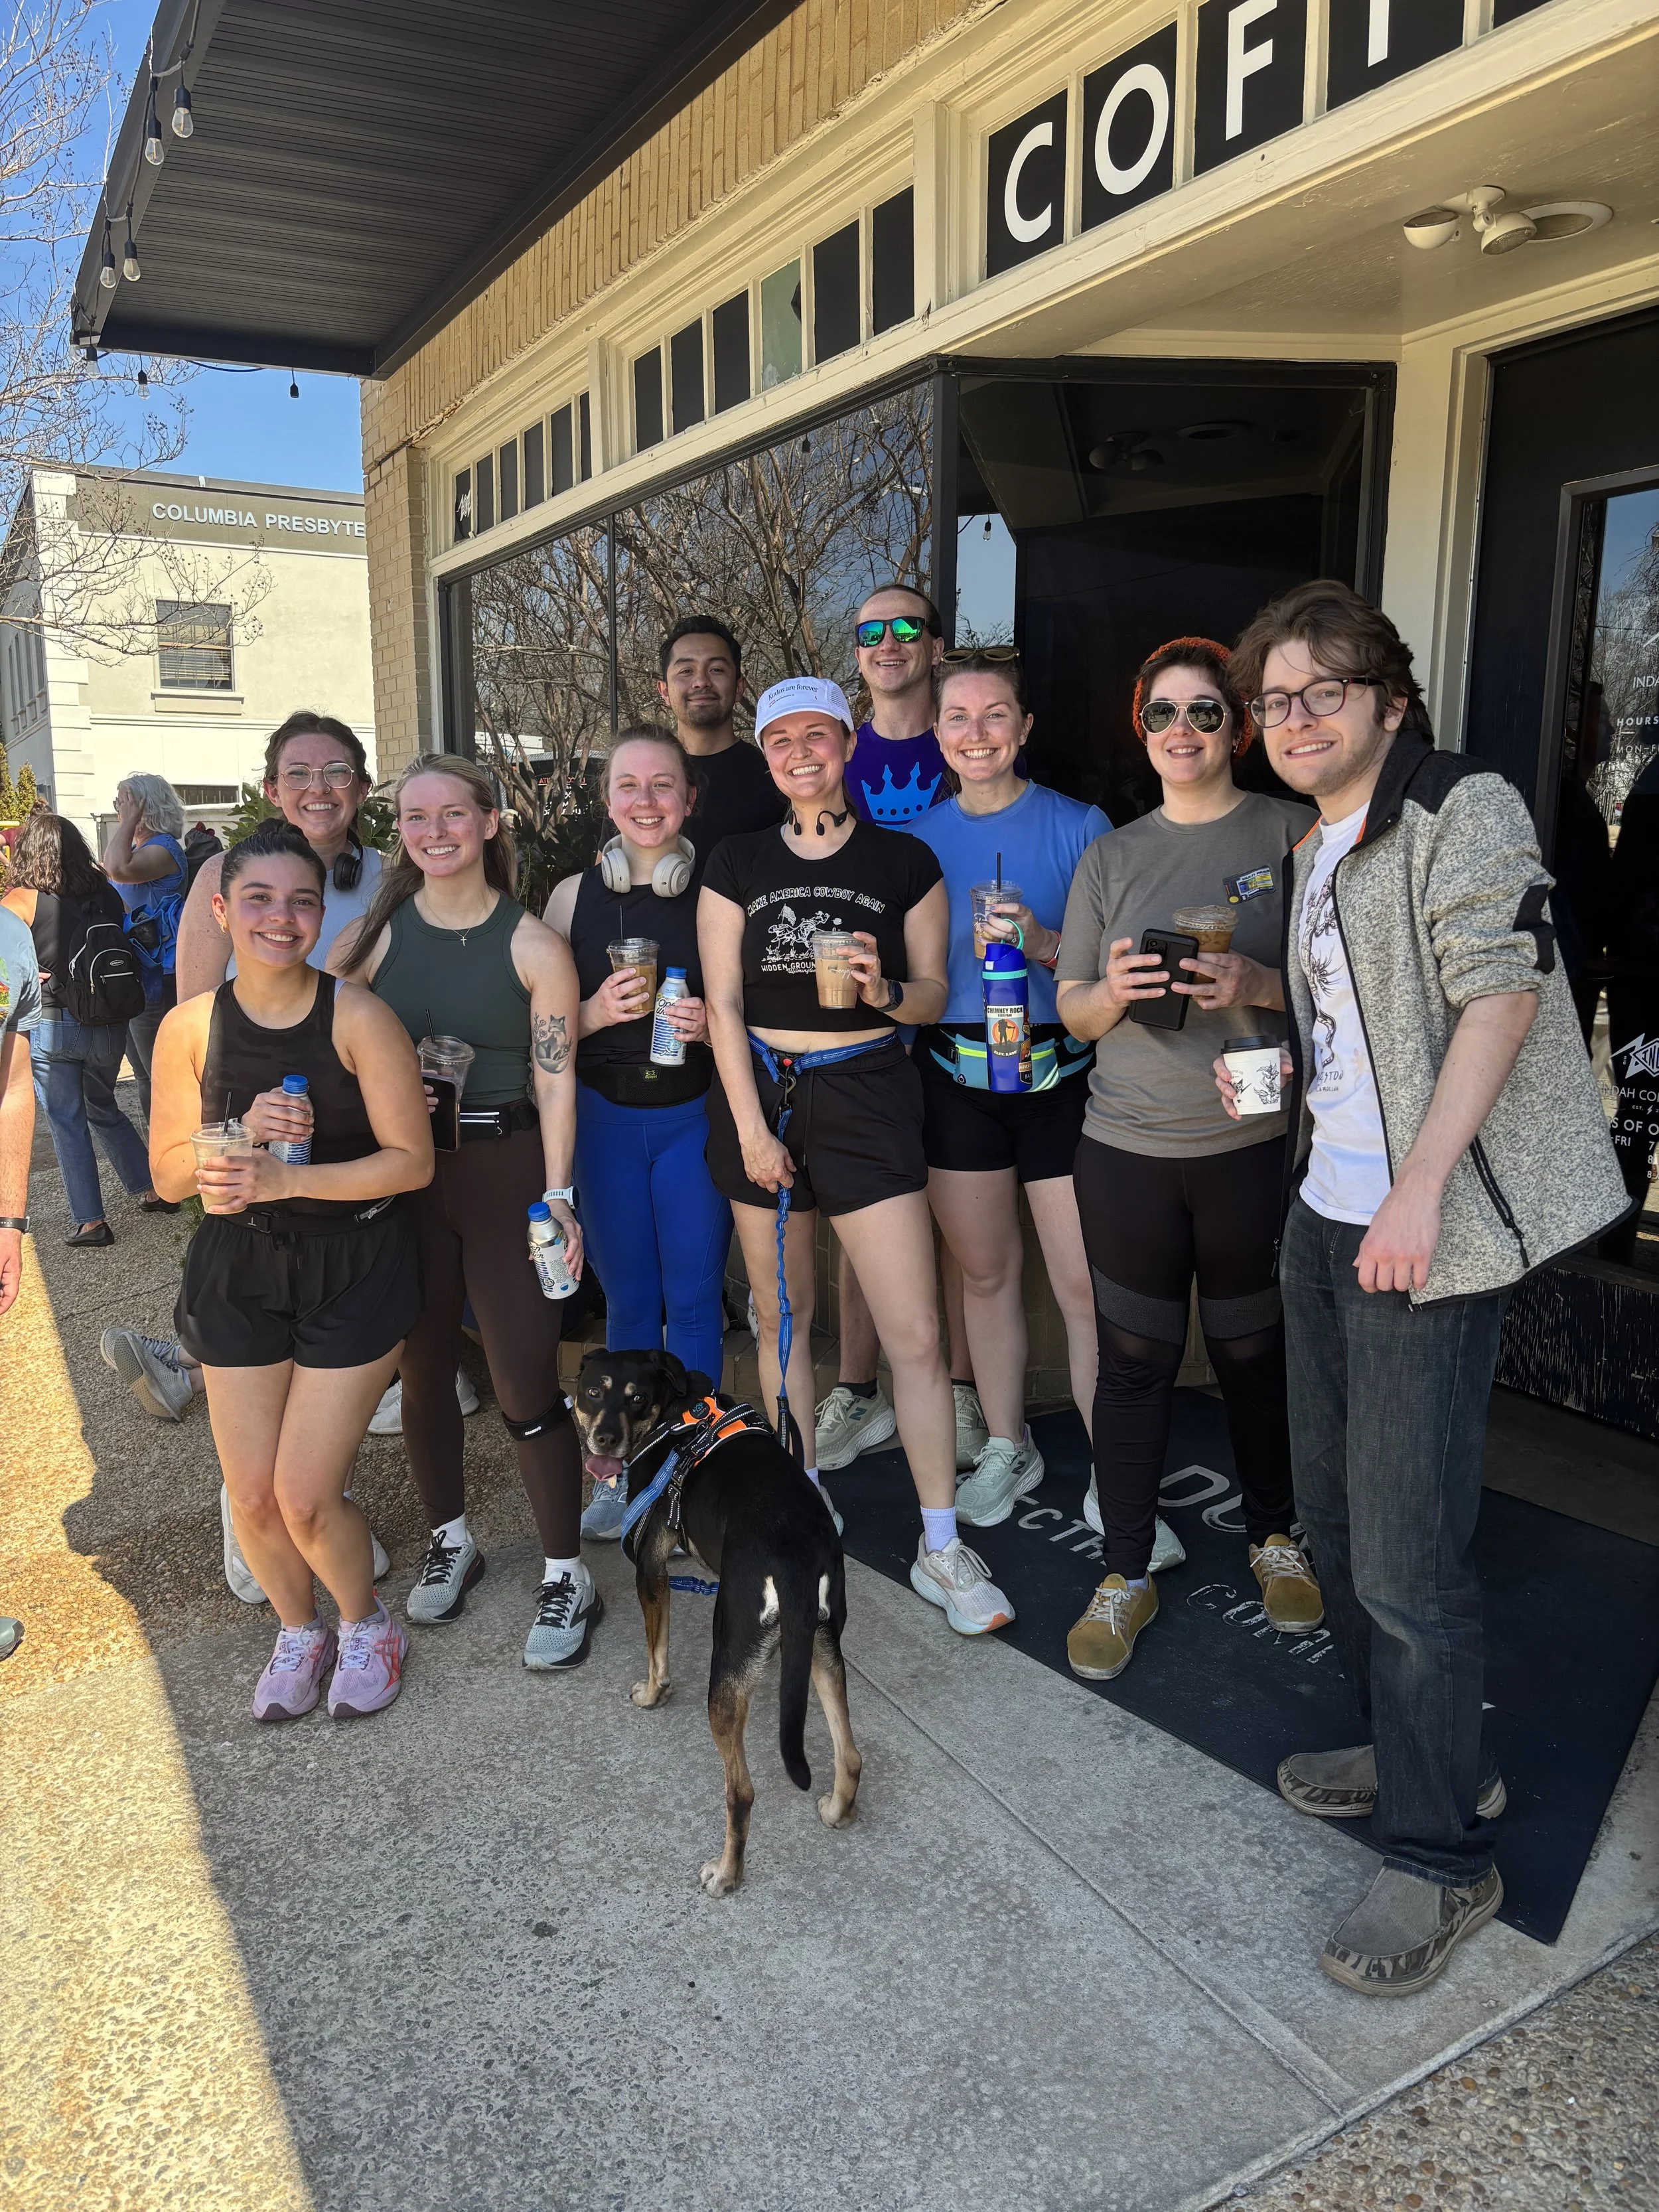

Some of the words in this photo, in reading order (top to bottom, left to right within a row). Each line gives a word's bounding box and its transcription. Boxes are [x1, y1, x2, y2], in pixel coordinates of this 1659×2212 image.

[152, 503, 258, 528] COLUMBIA
[768, 688, 784, 701] Kudos
[1617, 715, 1659, 727] HOURS
[747, 895, 768, 917] MAKE
[770, 887, 811, 903] AMERICA
[814, 887, 855, 901] COWBOY
[855, 893, 885, 914] AGAIN
[1624, 1119, 1643, 1133] OF
